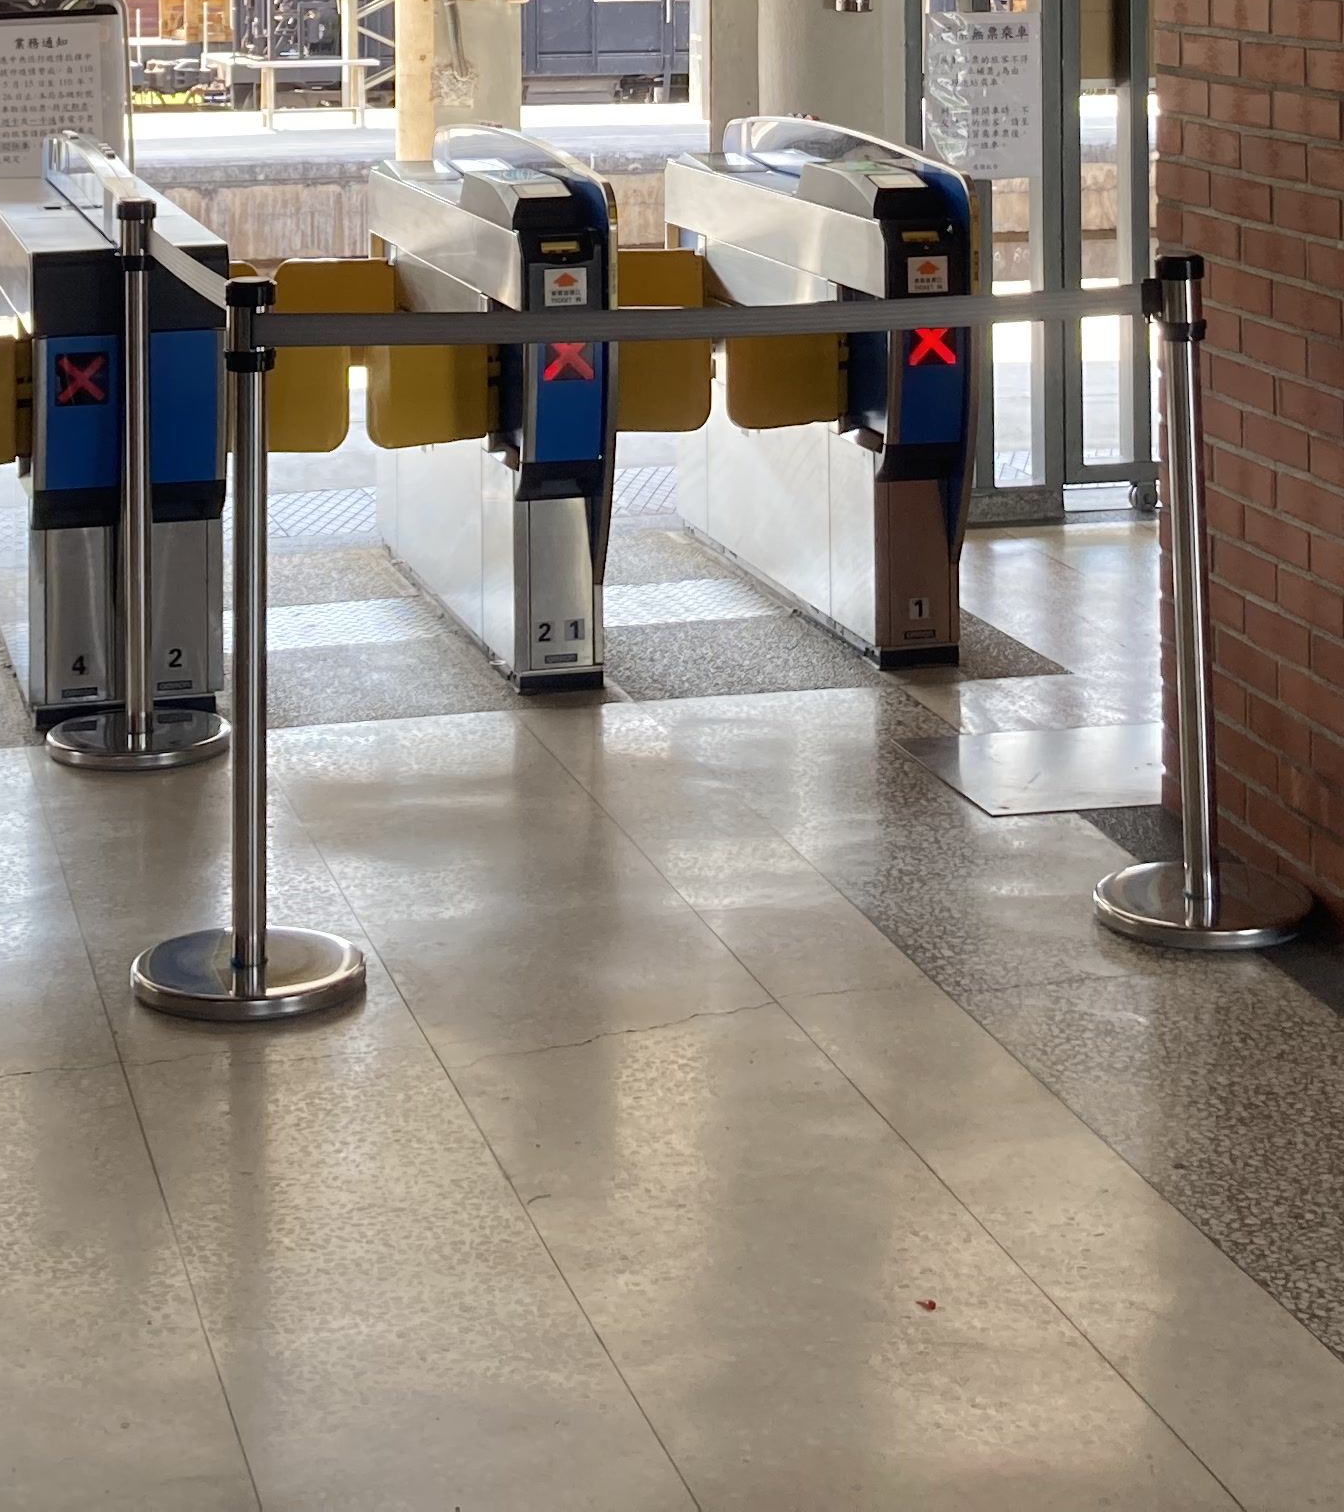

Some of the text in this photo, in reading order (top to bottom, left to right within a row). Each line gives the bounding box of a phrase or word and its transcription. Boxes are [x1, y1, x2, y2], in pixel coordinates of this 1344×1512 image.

[914, 600, 923, 617] 1
[538, 620, 579, 642] 2 1
[72, 655, 86, 675] 4
[169, 649, 182, 668] 2
